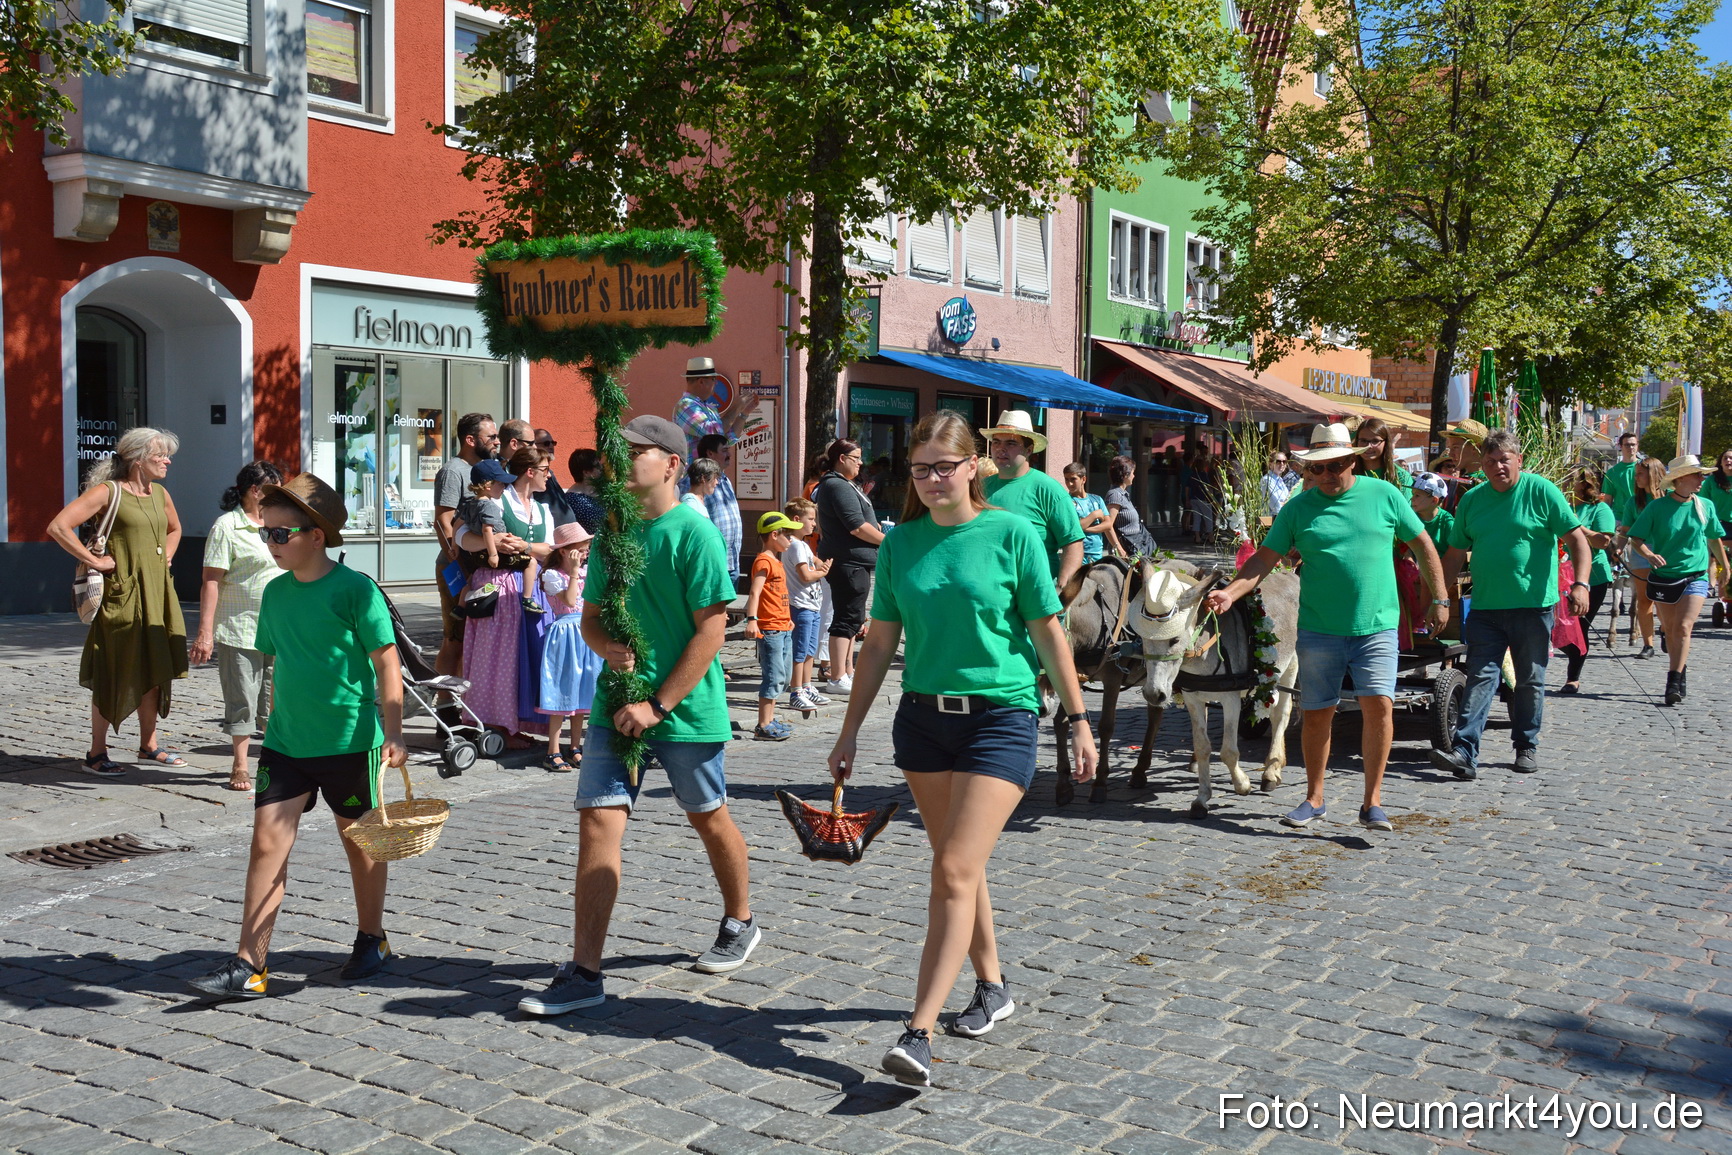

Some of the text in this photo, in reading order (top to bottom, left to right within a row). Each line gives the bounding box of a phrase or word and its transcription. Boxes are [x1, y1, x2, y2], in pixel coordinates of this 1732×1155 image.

[496, 259, 700, 317] Haubner's Ranch
[940, 302, 960, 320] vom
[354, 305, 473, 349] fielmann
[946, 312, 976, 338] FASS
[1308, 367, 1336, 393] LEDER
[850, 393, 914, 411] Spirituosen Whisky
[393, 413, 435, 428] fielmann
[737, 431, 773, 451] VENEZIA
